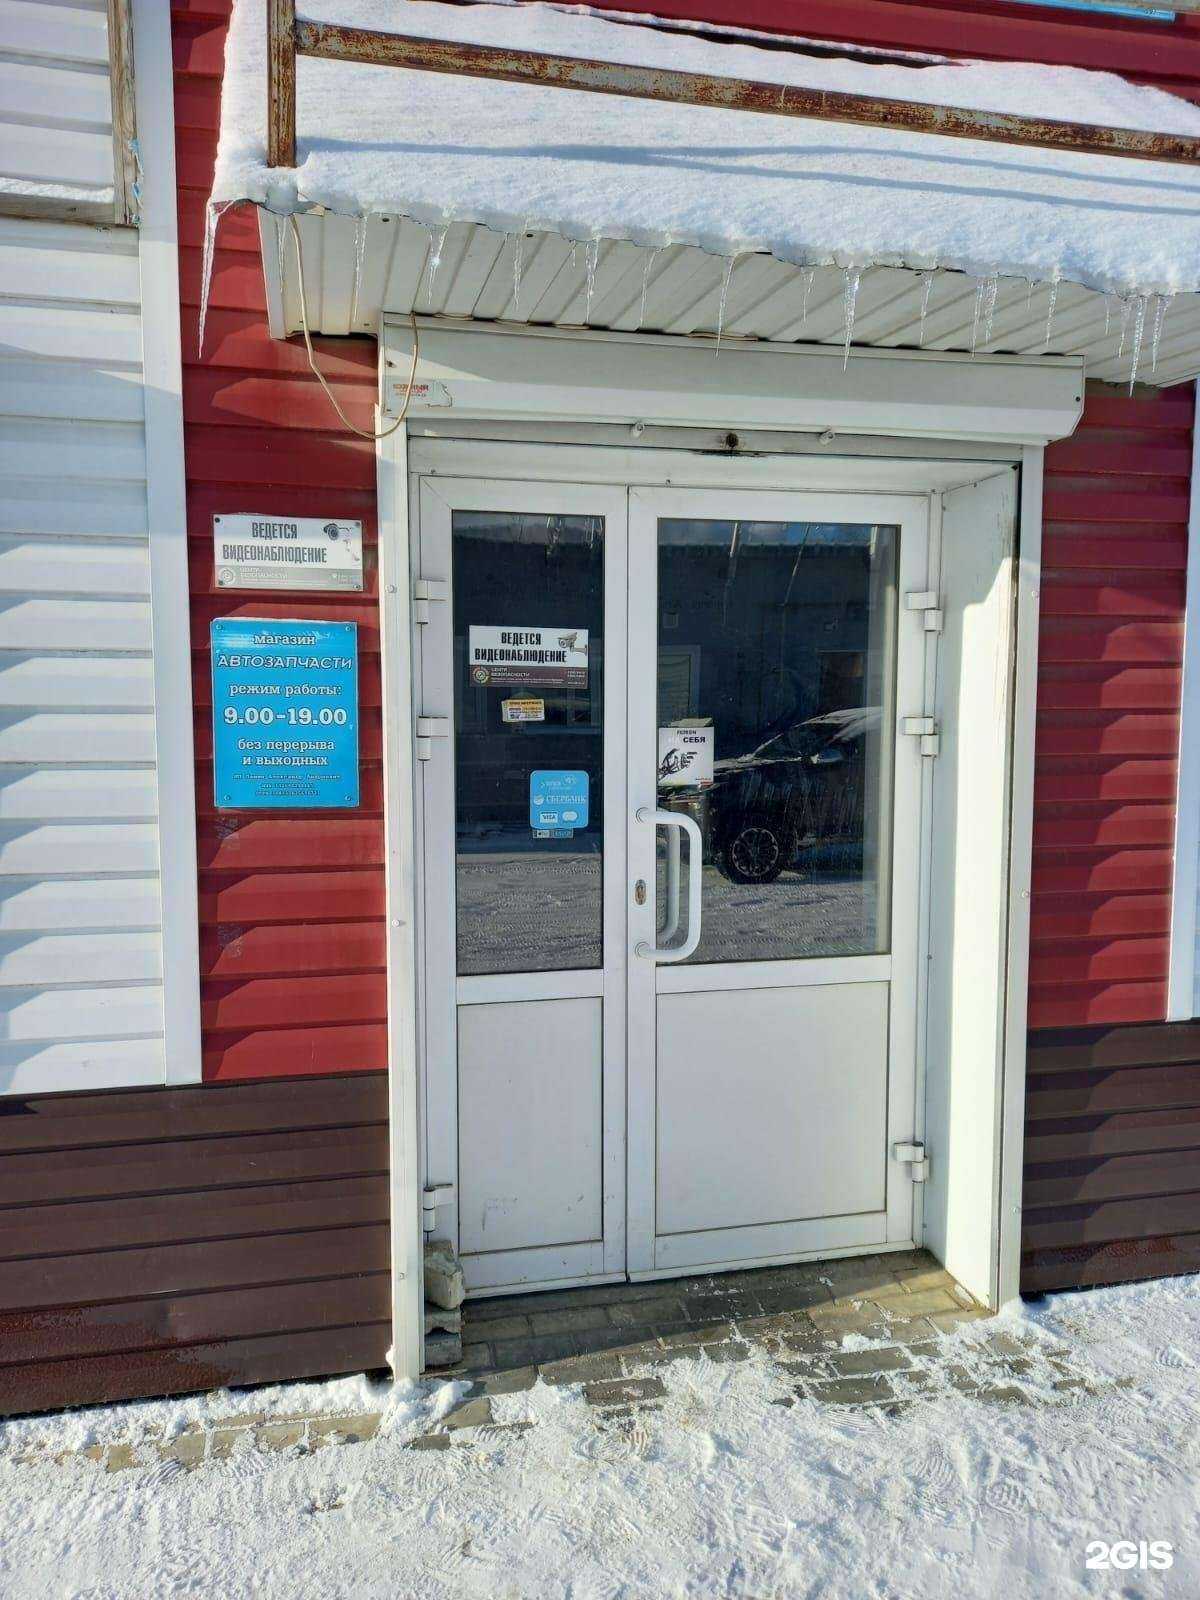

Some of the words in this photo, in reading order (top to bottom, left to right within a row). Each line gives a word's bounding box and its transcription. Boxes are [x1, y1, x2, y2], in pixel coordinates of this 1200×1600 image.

[252, 521, 298, 541] ВЕДЕТСЯ
[222, 544, 328, 564] ВИДЕОНАБЛЮДЕНИЕ
[254, 633, 317, 646] магазин
[501, 631, 542, 647] ВЕДЕТСЯ
[218, 654, 353, 670] АВТОЗАПЧАСТИ
[474, 648, 568, 664] ВИДЕОНАБЛЮДЕНИЕ
[228, 683, 281, 697] режим
[285, 682, 343, 698] работы:
[223, 705, 348, 726] 9.00-19.00
[237, 738, 262, 751] без
[266, 739, 335, 754] перерыва
[683, 736, 707, 744] СЕБЯ
[241, 756, 252, 766] и
[256, 756, 329, 767] выходных
